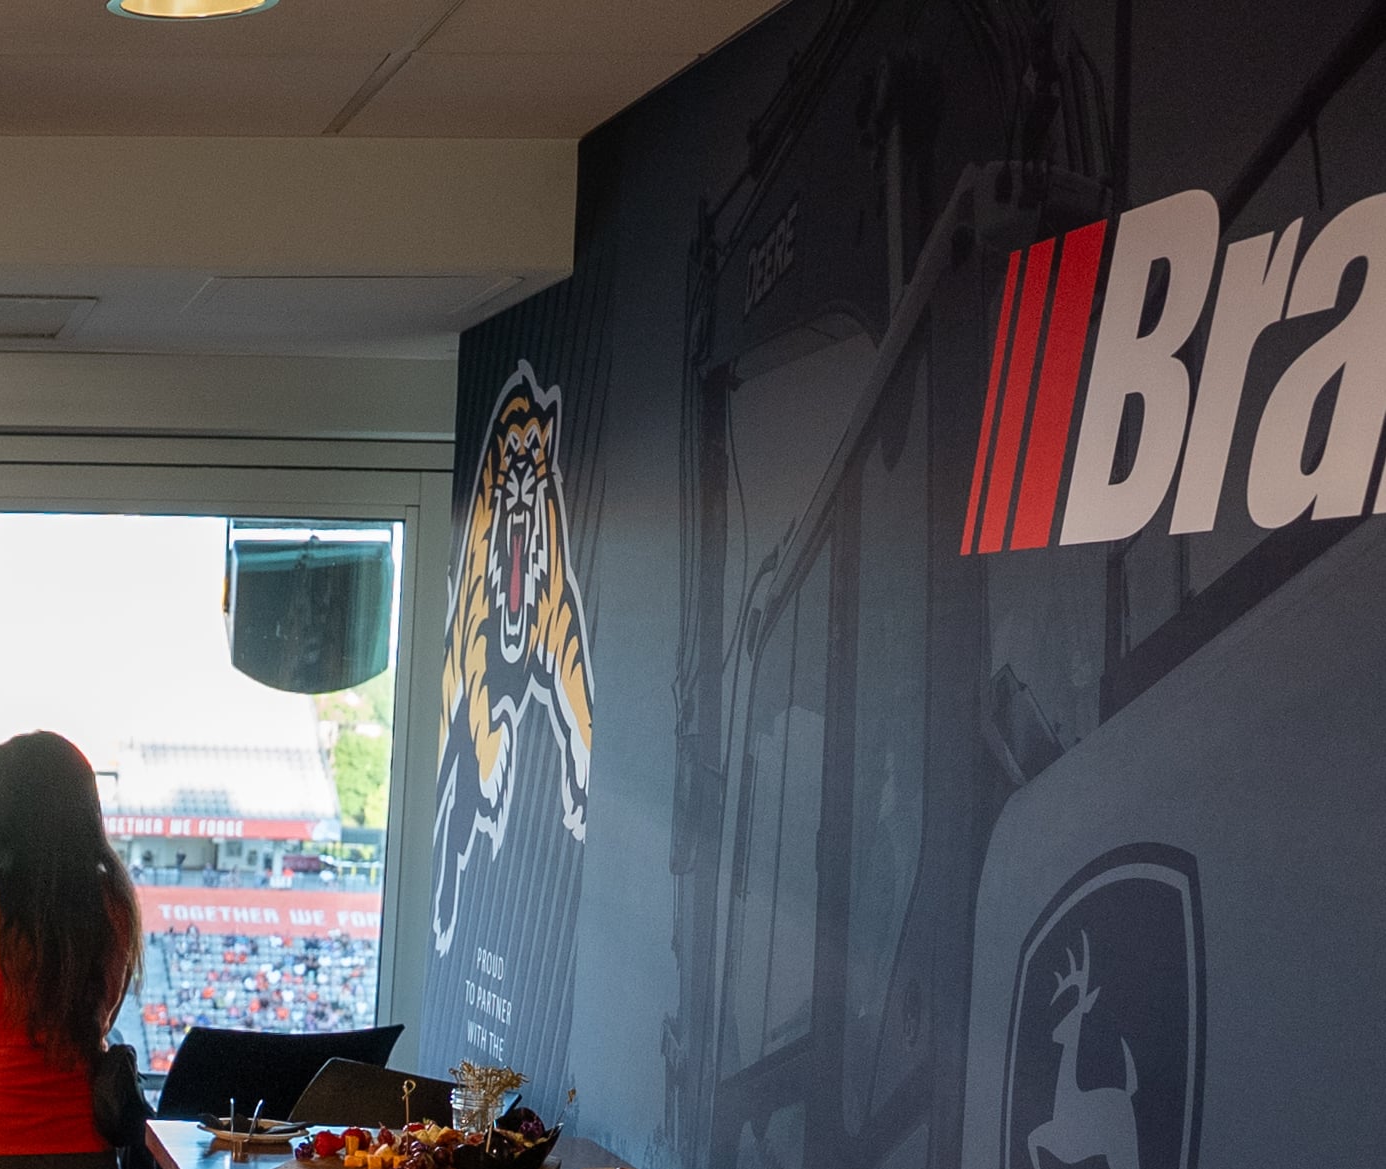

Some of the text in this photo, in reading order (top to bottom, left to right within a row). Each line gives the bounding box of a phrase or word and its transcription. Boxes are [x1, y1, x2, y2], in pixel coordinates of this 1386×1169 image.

[1059, 189, 1386, 546] Bra
[104, 817, 163, 835] GETHER
[158, 903, 280, 925] TOGETHER
[289, 909, 325, 927] WE
[476, 947, 504, 980] PROUD
[465, 980, 512, 1026] TO PARTNER
[468, 1019, 504, 1062] WITH THE
